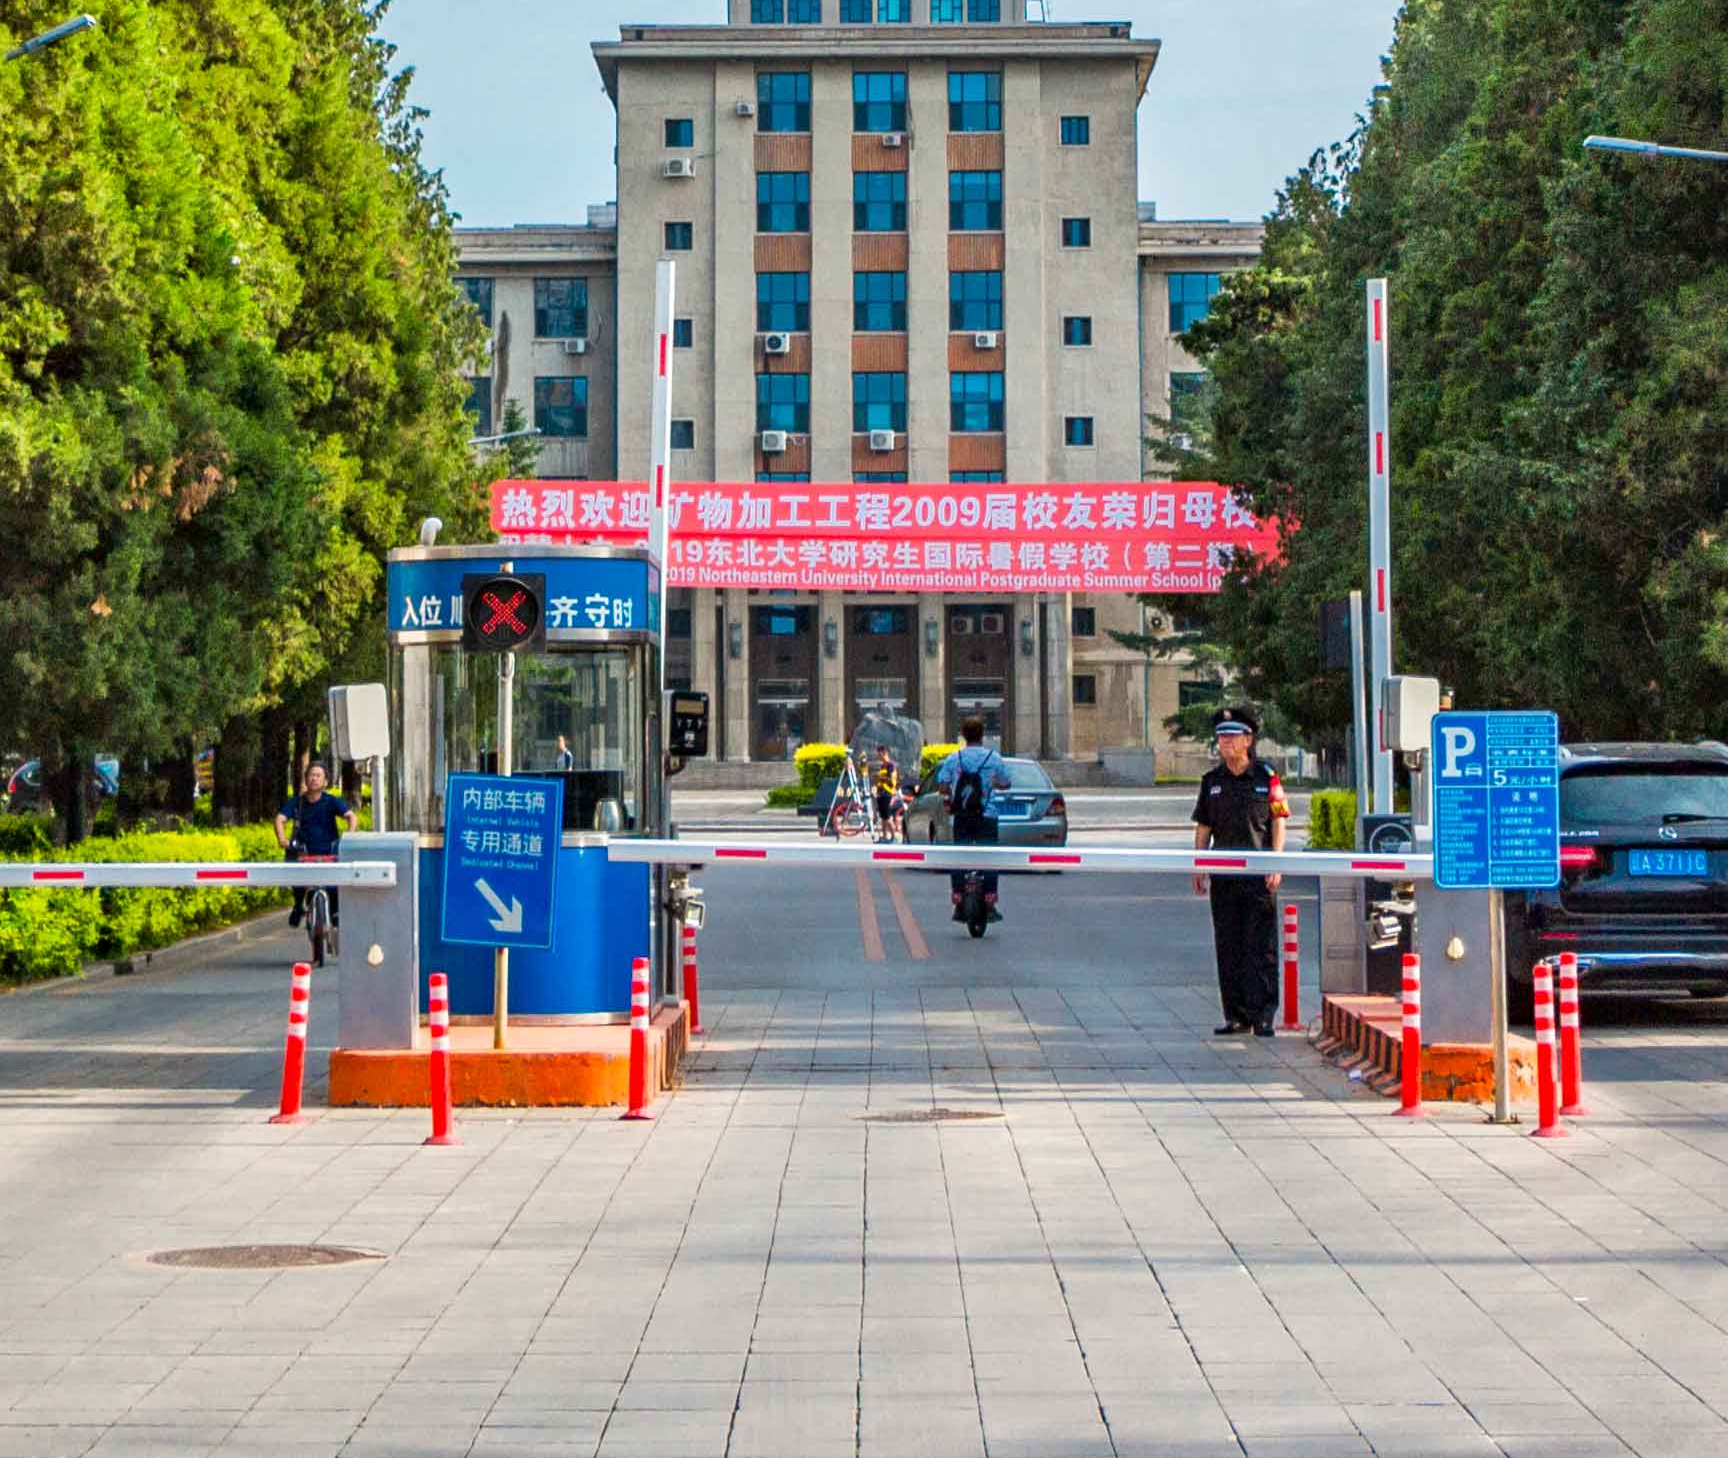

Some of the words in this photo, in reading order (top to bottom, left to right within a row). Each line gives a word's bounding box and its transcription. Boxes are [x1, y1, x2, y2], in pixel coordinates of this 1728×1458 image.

[666, 566, 696, 583] 019
[702, 568, 797, 584] Northeastern
[801, 570, 877, 588] University
[881, 570, 977, 587] International
[980, 572, 1080, 589] Postgraduate
[1084, 572, 1148, 587] Summer
[1151, 572, 1203, 587] School
[545, 592, 633, 628] 齐守时
[1441, 726, 1476, 778] P
[463, 786, 545, 814] 内部车辆
[460, 829, 544, 857] 专用通道
